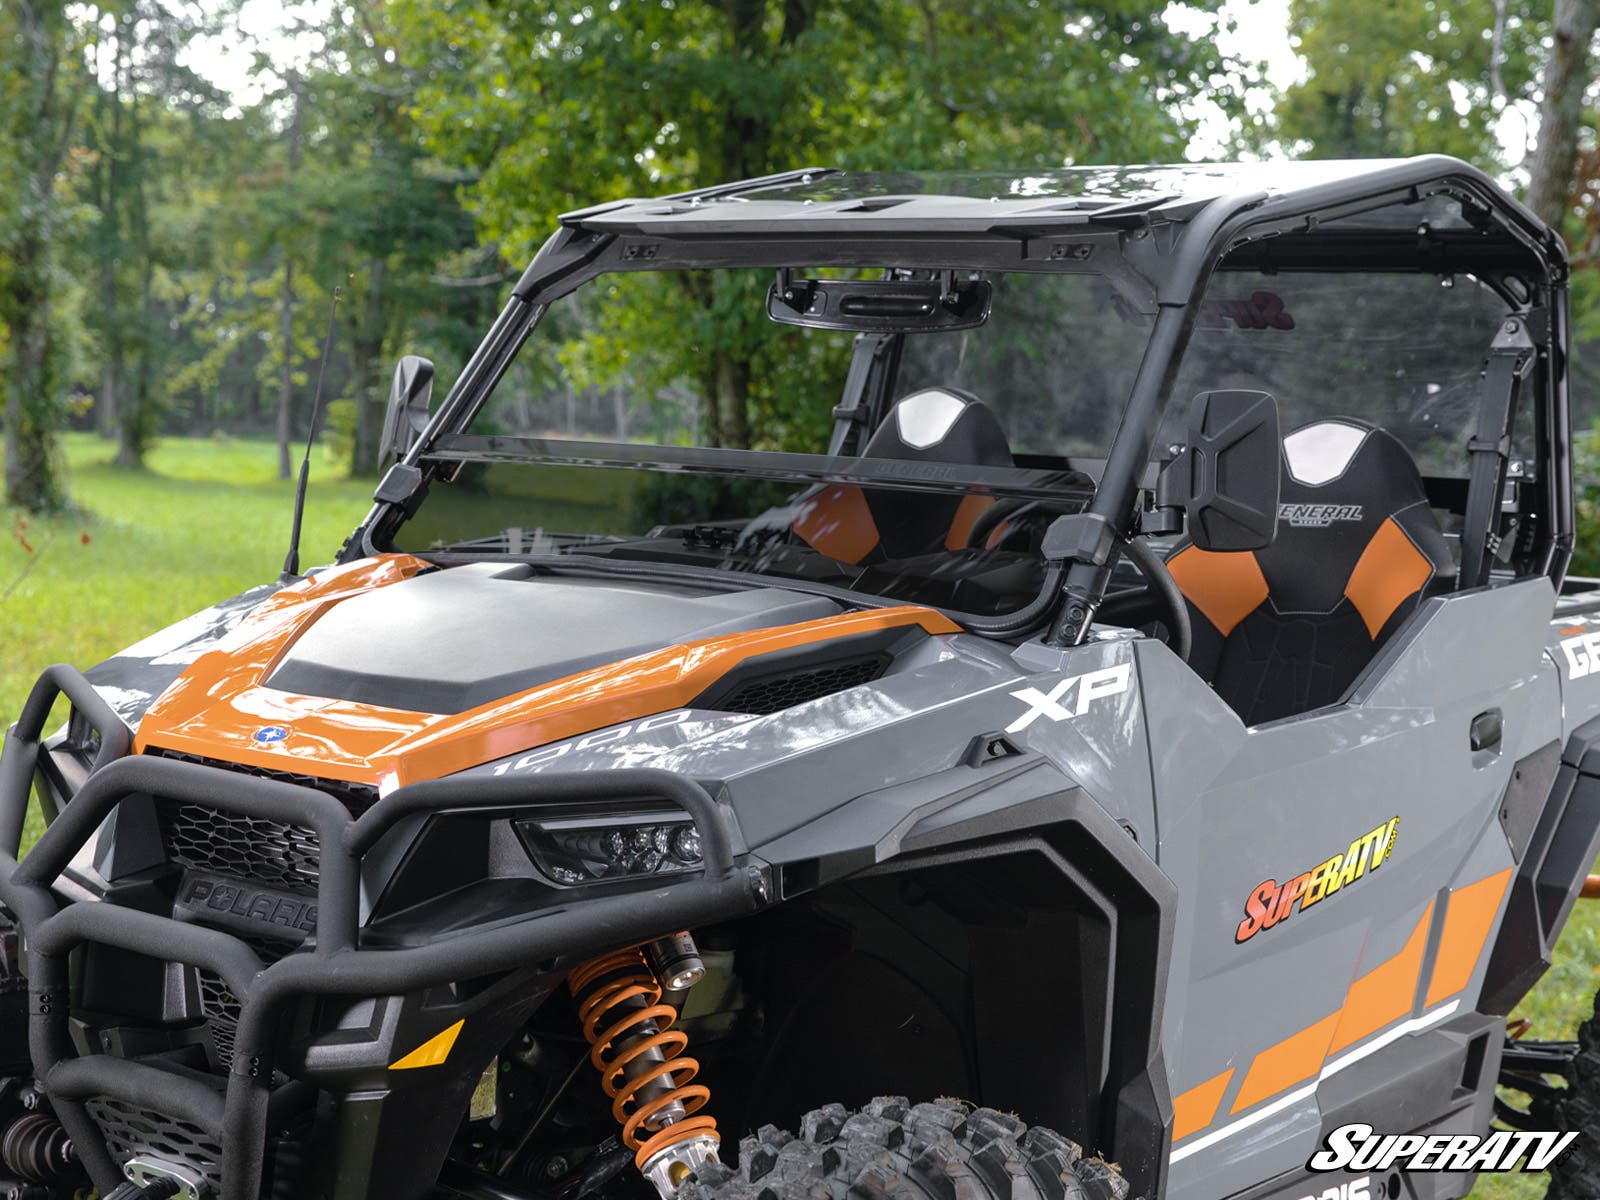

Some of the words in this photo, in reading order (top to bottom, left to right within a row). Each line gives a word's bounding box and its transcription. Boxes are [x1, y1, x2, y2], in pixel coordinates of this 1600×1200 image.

[1278, 503, 1363, 521] ENERAL
[1004, 662, 1131, 734] XP
[493, 710, 692, 776] 1000
